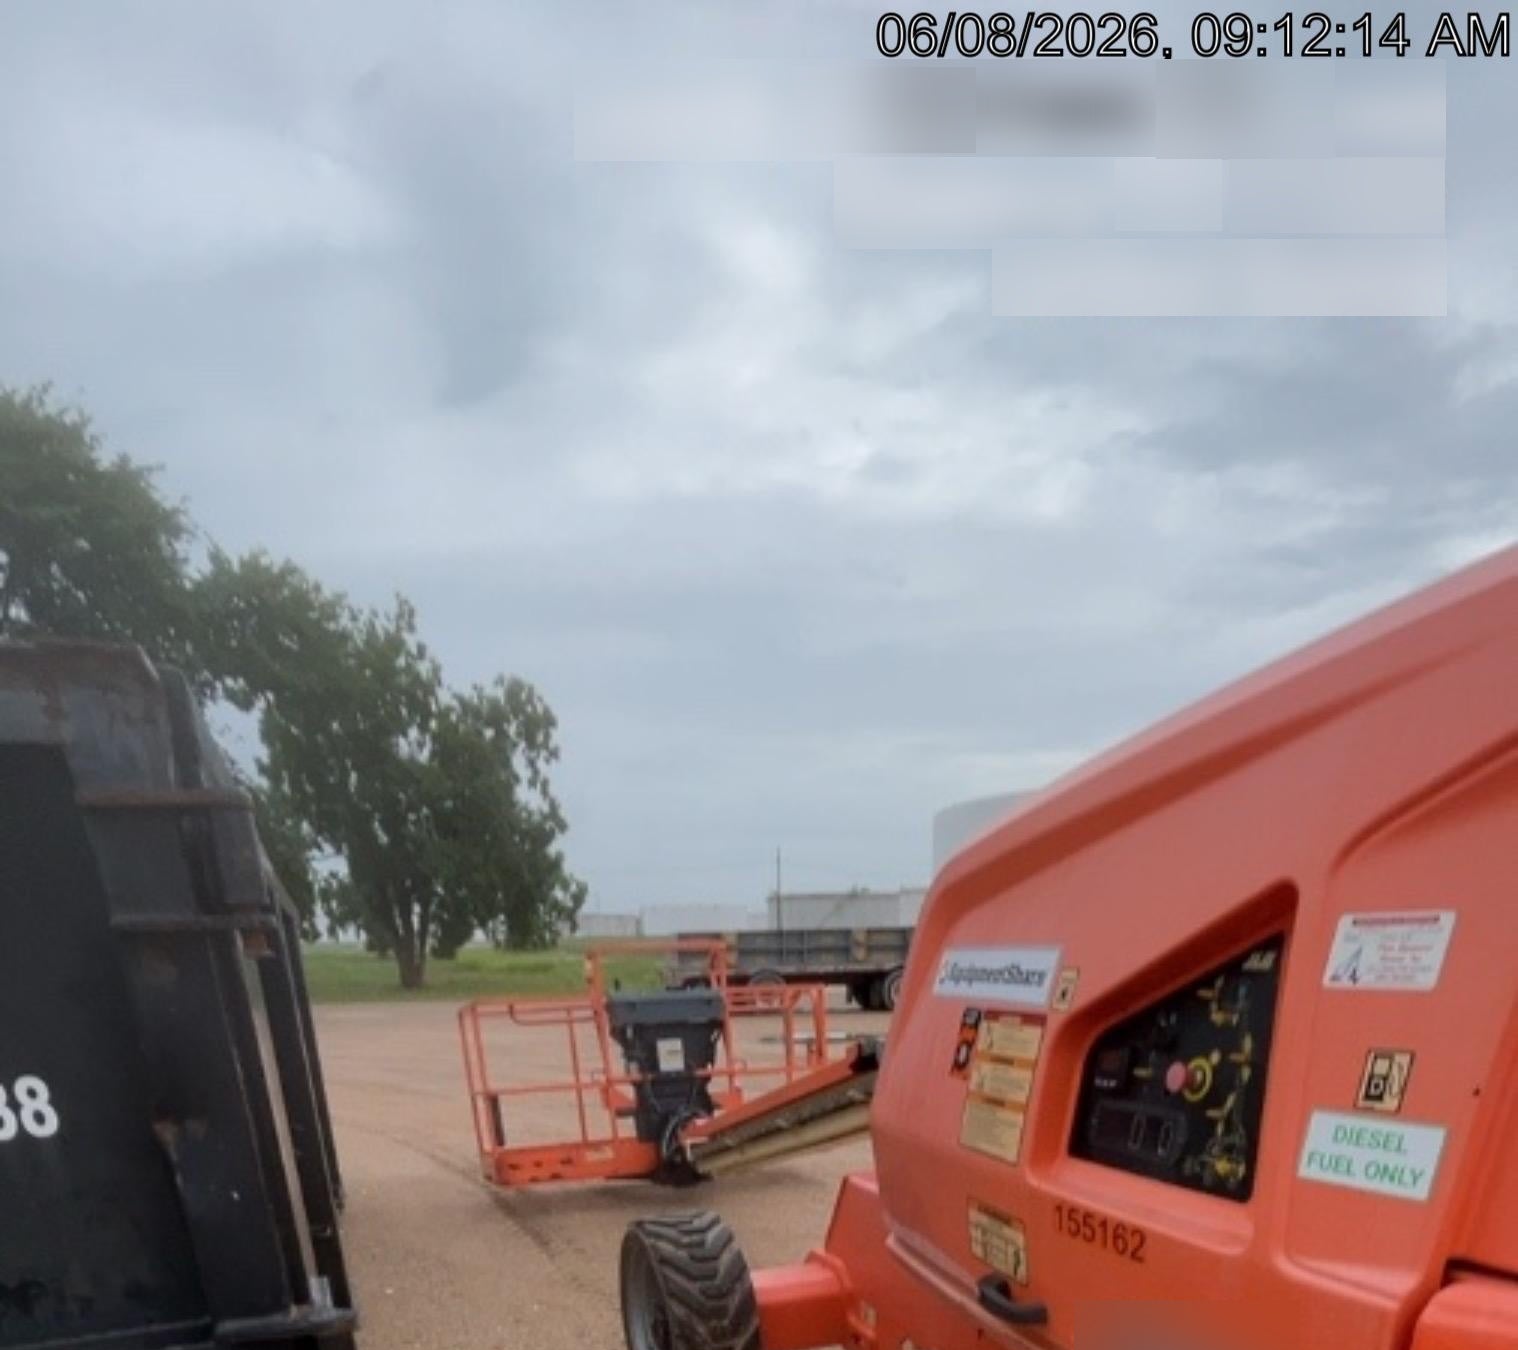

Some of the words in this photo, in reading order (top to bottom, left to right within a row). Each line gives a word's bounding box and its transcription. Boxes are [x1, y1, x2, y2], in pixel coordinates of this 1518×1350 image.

[1333, 1124, 1408, 1153] DIESEL
[1307, 1151, 1356, 1177] FUEL
[1364, 1160, 1426, 1187] ONLY
[1055, 1203, 1147, 1263] 155162
